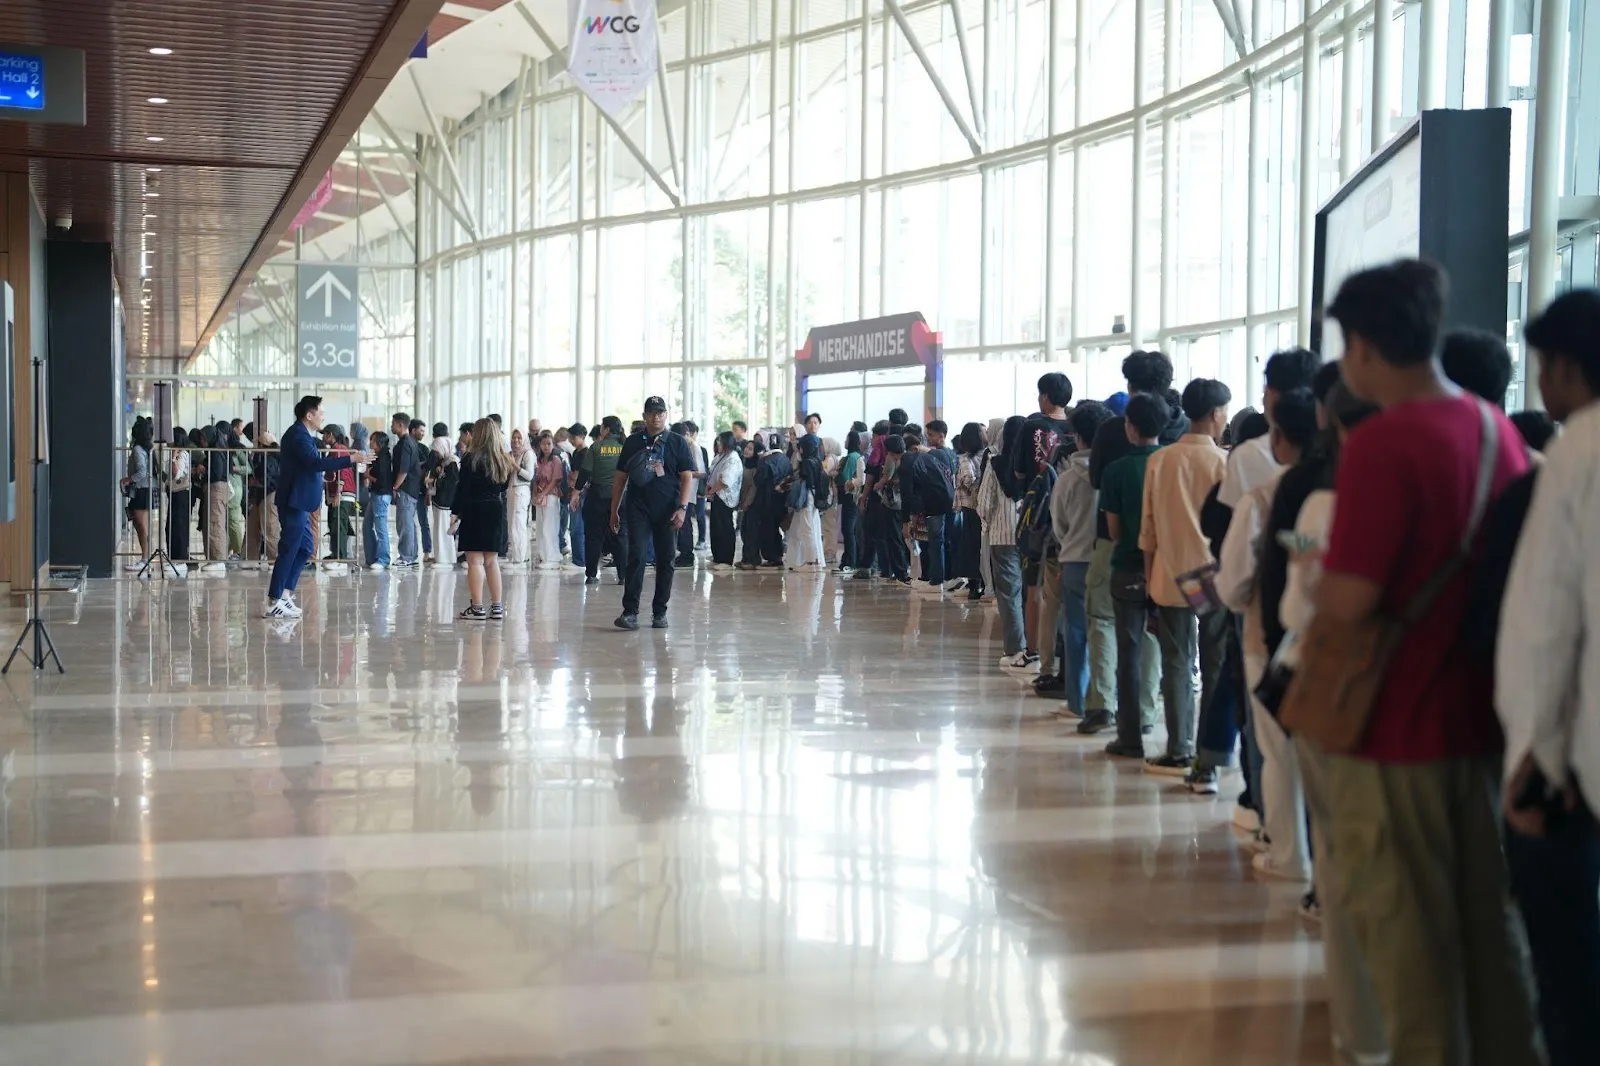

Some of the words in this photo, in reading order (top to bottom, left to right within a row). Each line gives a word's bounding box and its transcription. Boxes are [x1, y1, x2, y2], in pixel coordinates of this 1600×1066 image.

[582, 15, 640, 34] WCG
[3, 71, 28, 83] Hall
[31, 73, 39, 84] 2
[302, 342, 354, 368] 3,3a
[818, 328, 905, 363] MERCHANDISE
